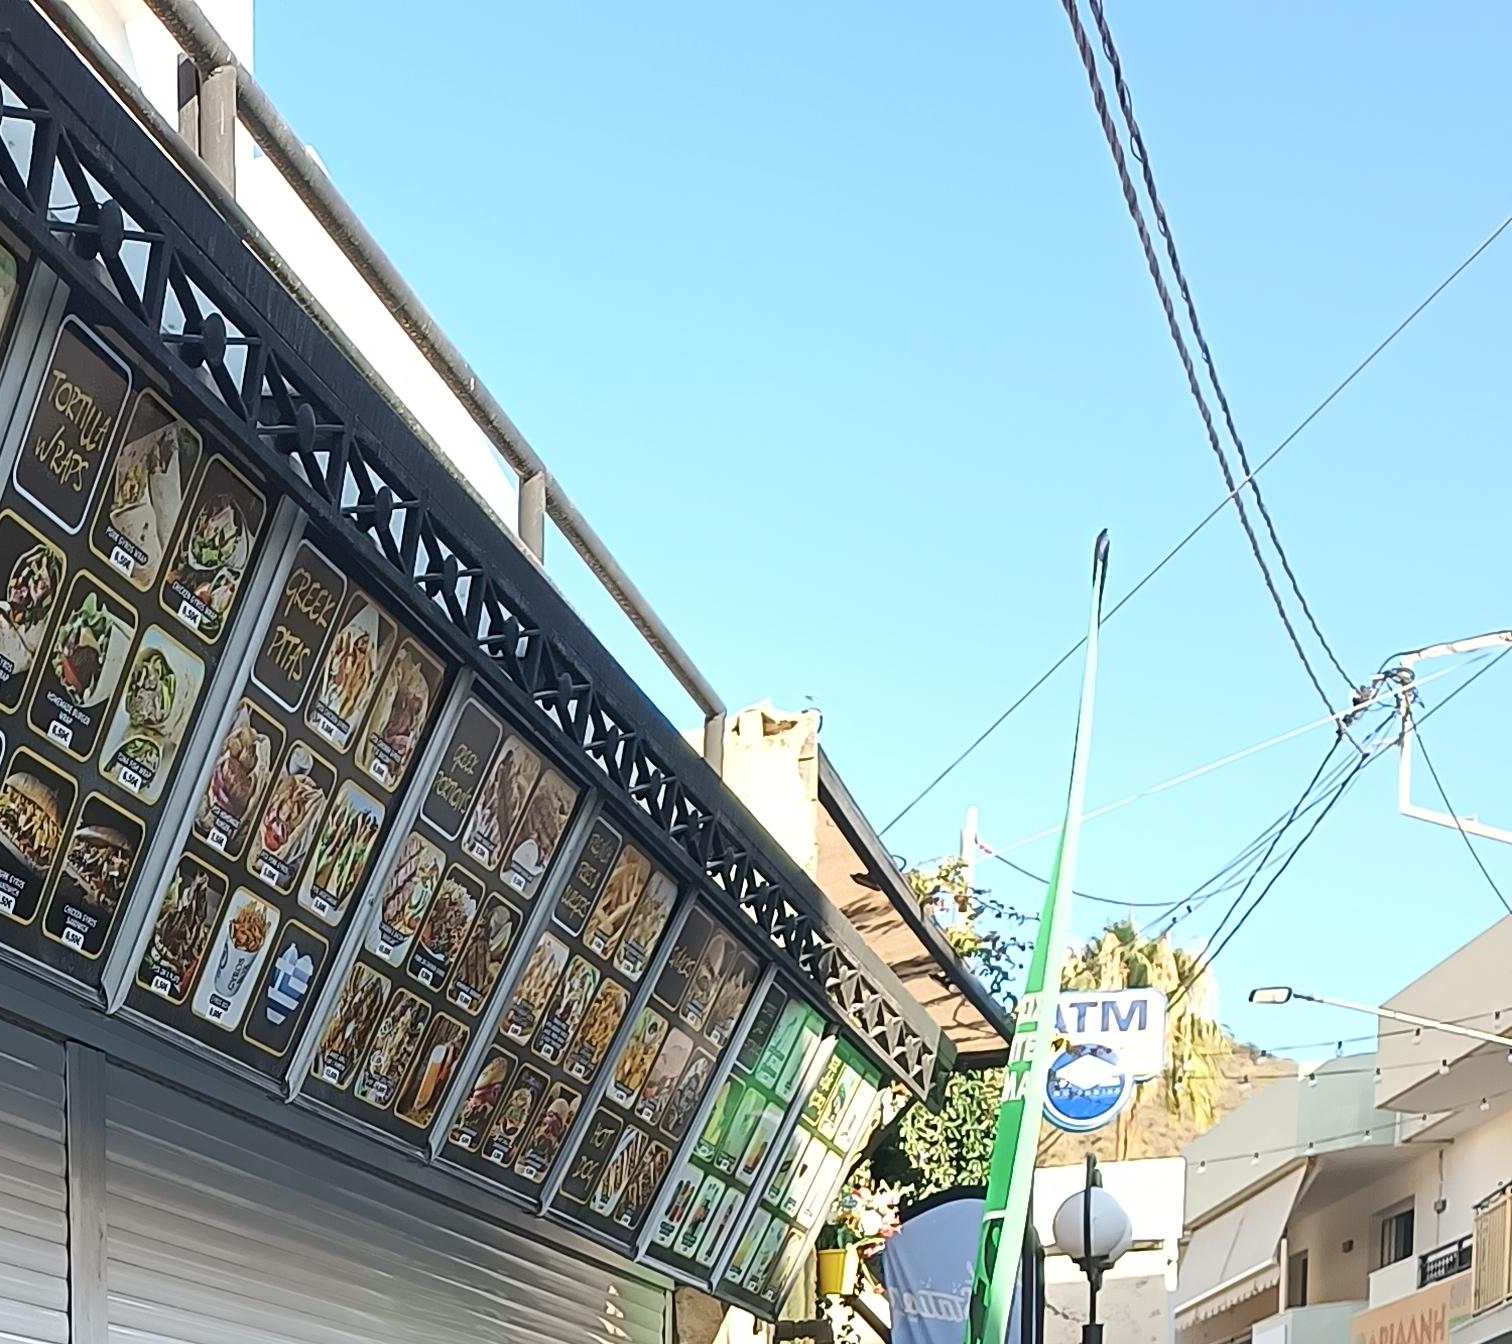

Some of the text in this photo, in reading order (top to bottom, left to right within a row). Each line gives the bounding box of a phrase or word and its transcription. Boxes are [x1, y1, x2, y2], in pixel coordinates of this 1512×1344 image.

[48, 369, 113, 453] TORTILLA
[34, 425, 90, 491] WRAPS
[285, 567, 336, 628] GREEK
[267, 625, 311, 682] PITAS
